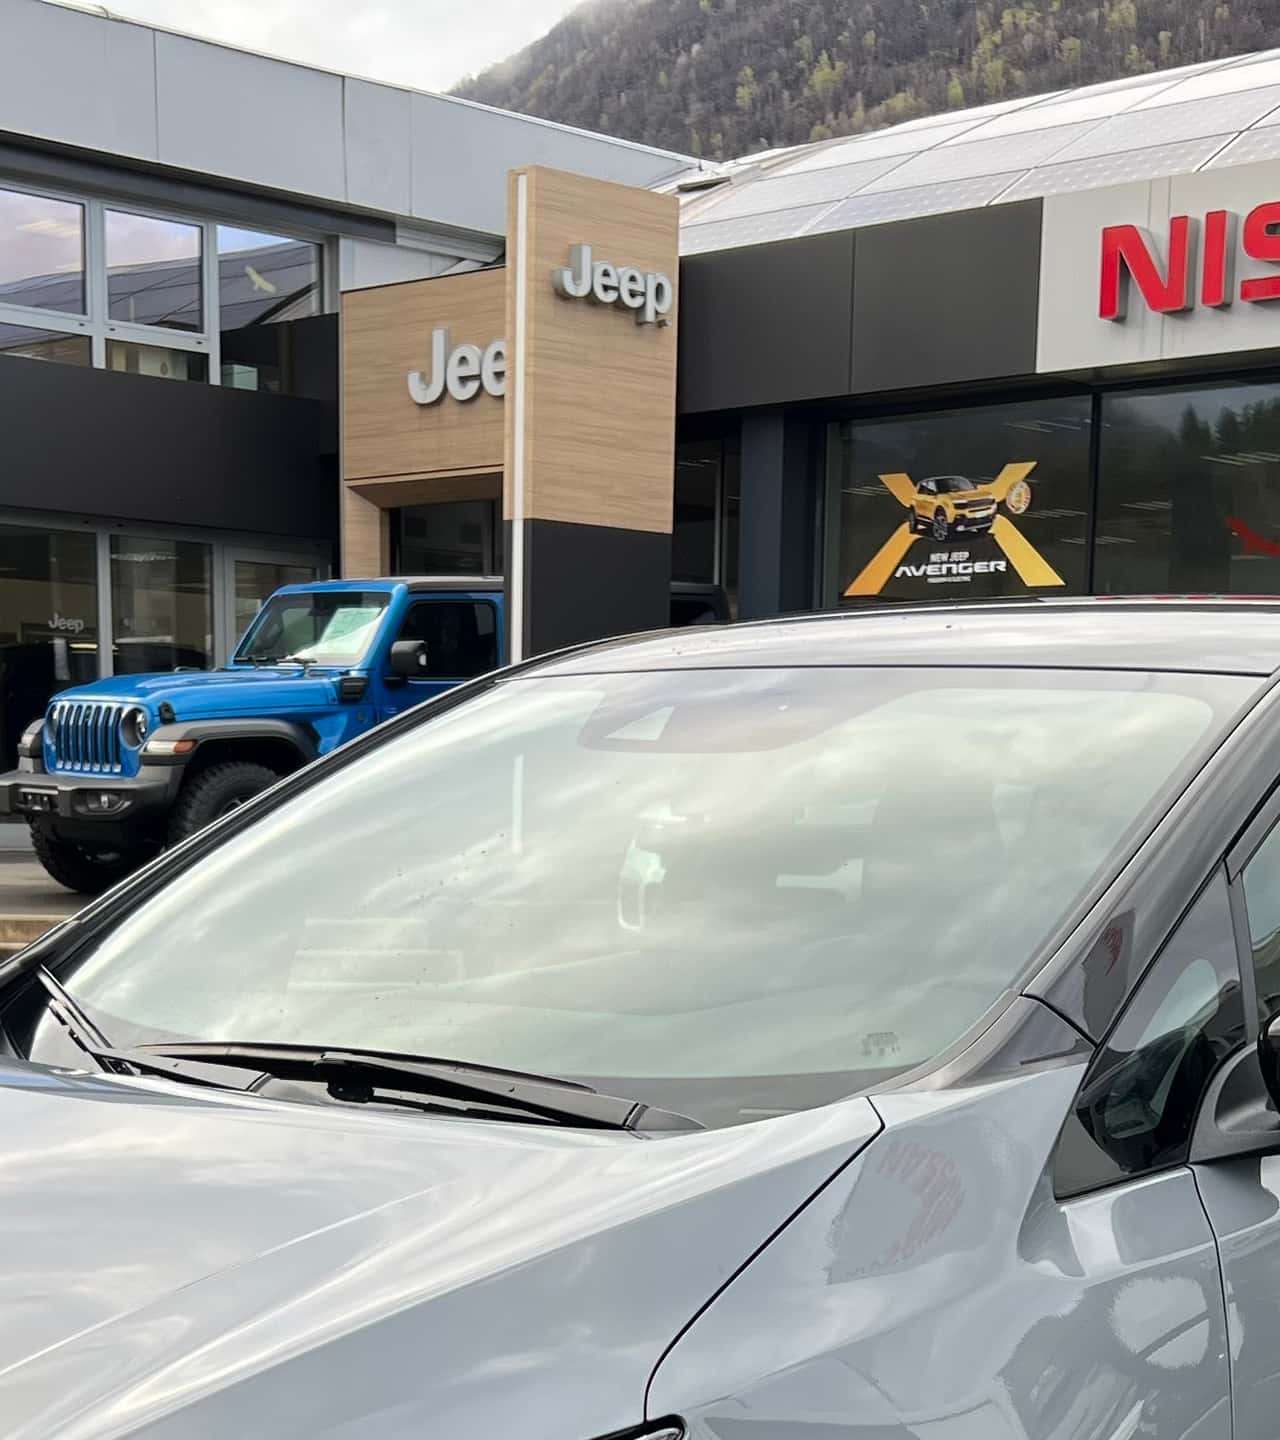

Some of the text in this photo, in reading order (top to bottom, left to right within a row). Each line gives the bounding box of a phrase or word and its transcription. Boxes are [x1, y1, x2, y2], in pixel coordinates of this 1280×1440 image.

[554, 243, 673, 325] Jeep
[407, 327, 505, 406] Jee
[894, 560, 1007, 578] AVENGER
[48, 611, 84, 634] Jeep
